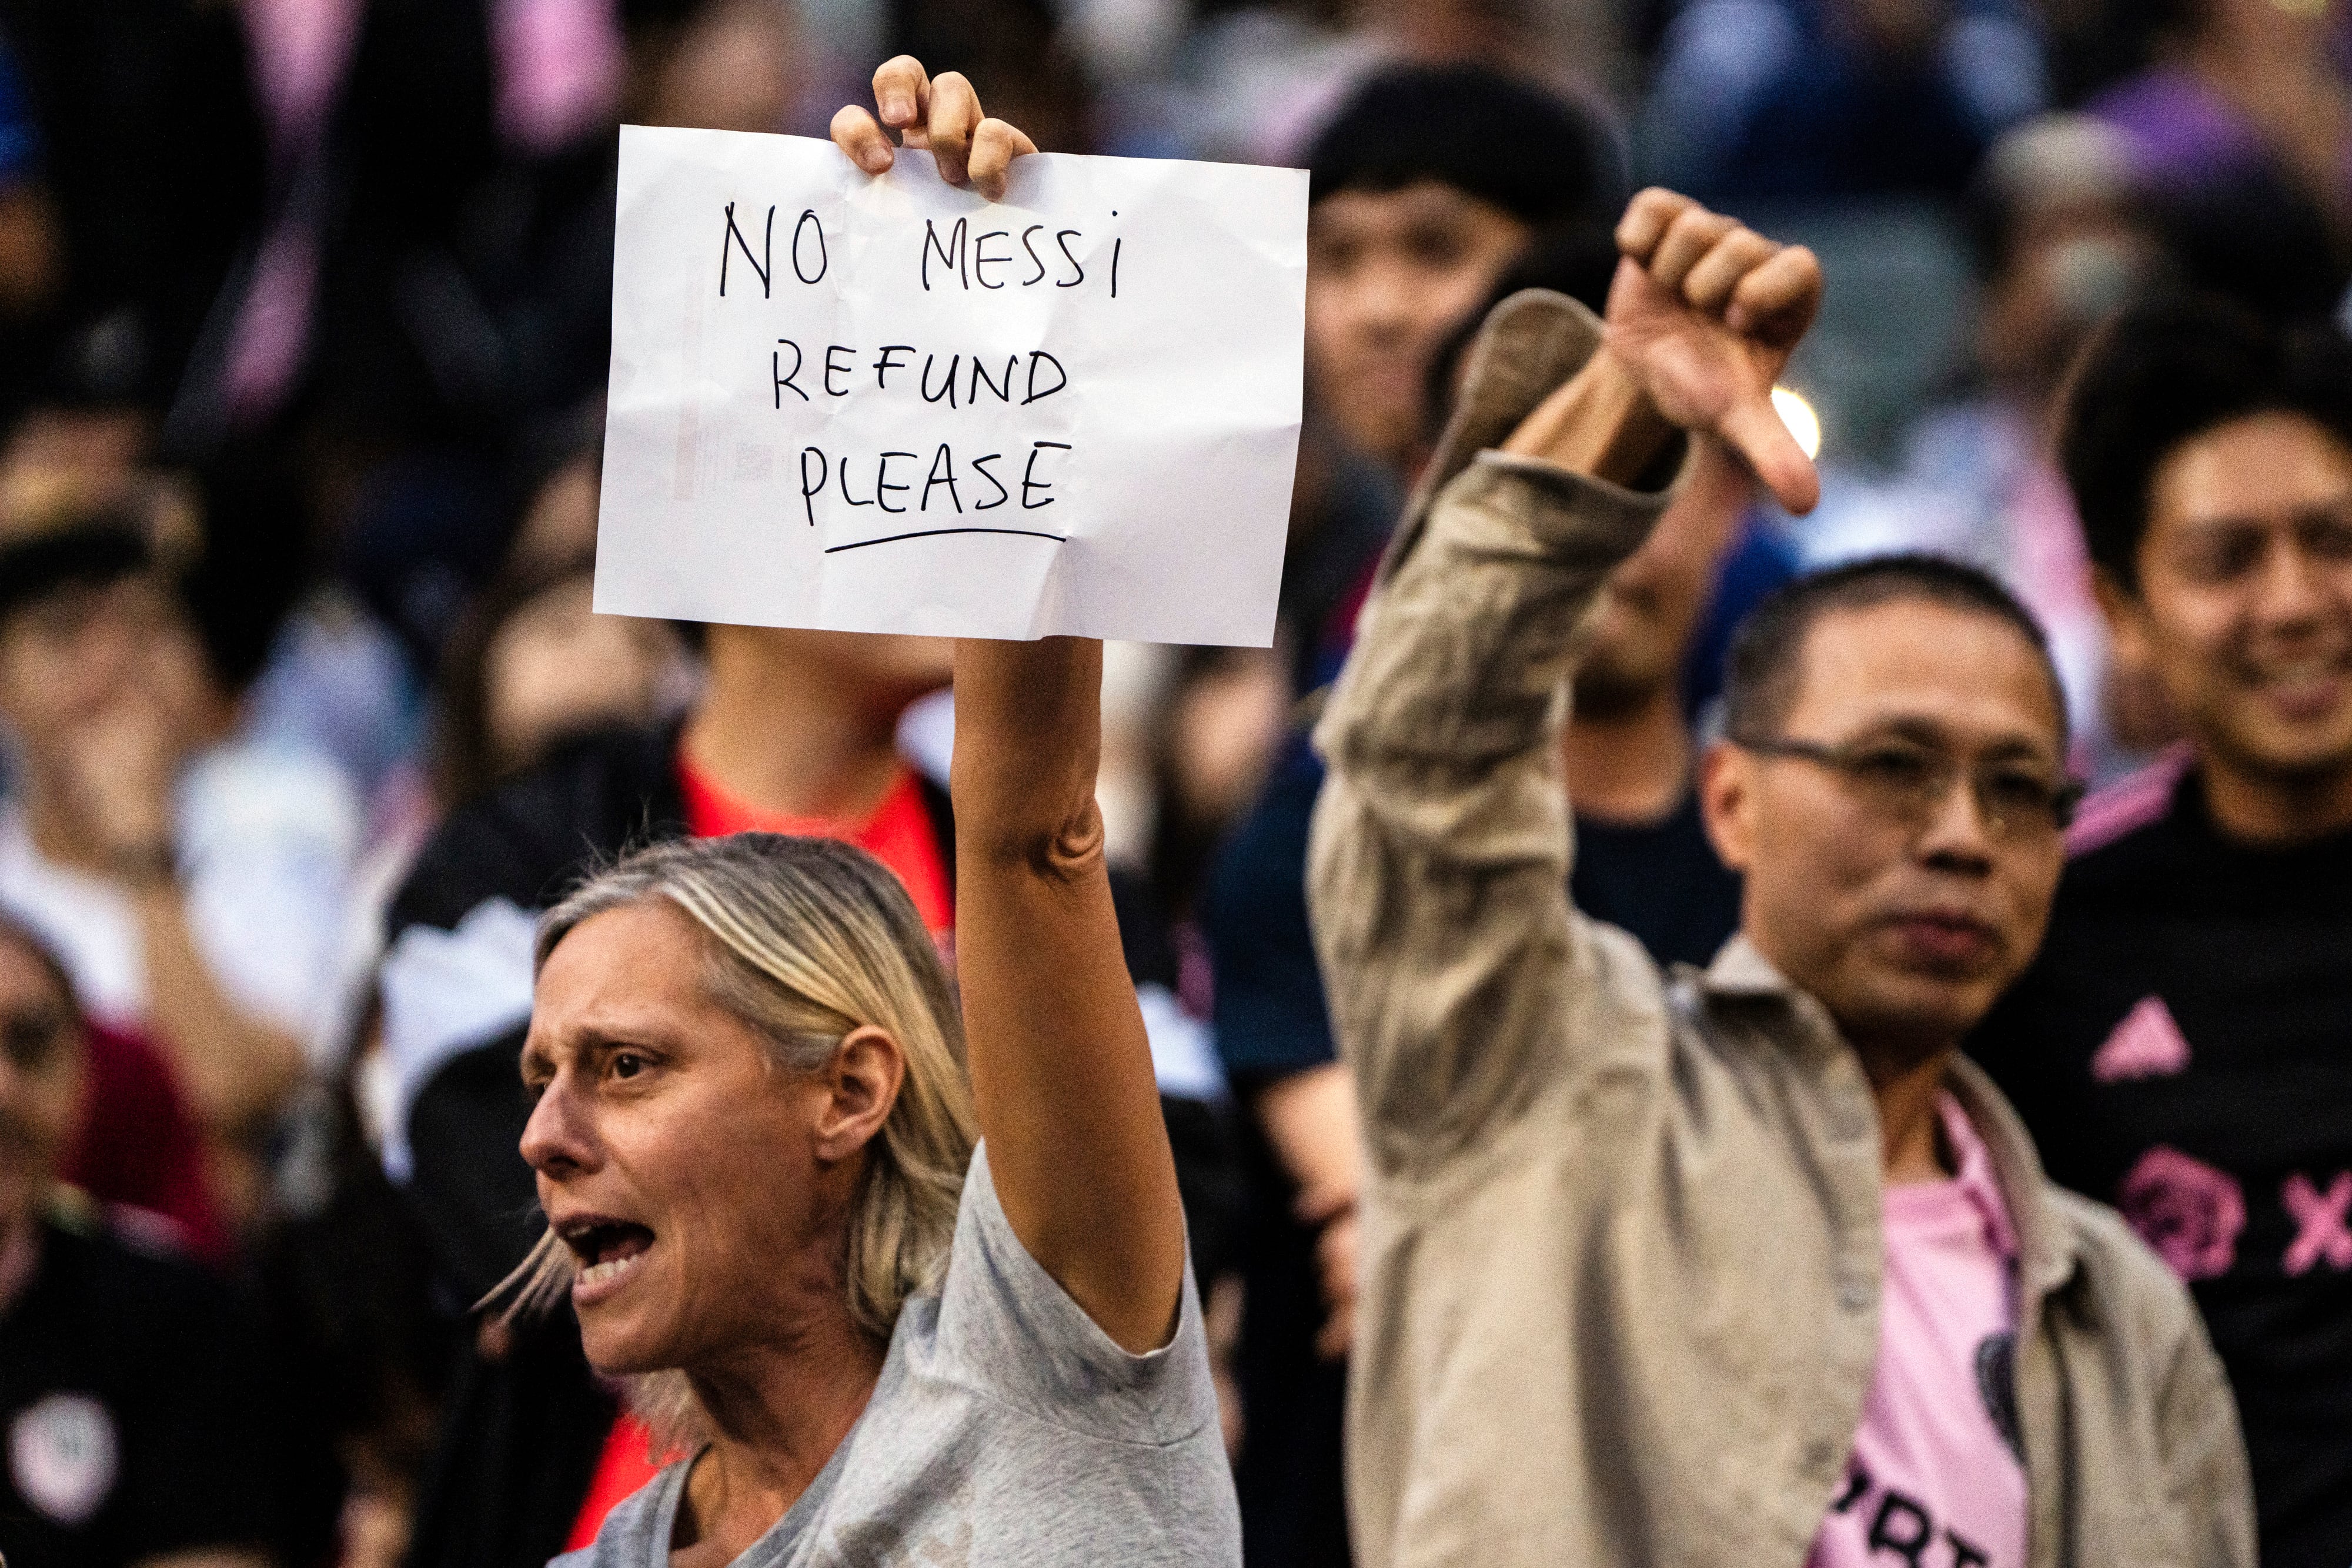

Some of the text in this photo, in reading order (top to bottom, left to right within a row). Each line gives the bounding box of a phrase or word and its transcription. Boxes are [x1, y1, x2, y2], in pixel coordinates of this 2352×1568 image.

[720, 201, 827, 299] NO
[773, 339, 1067, 410] REFUND
[801, 441, 1072, 527] PLEASE
